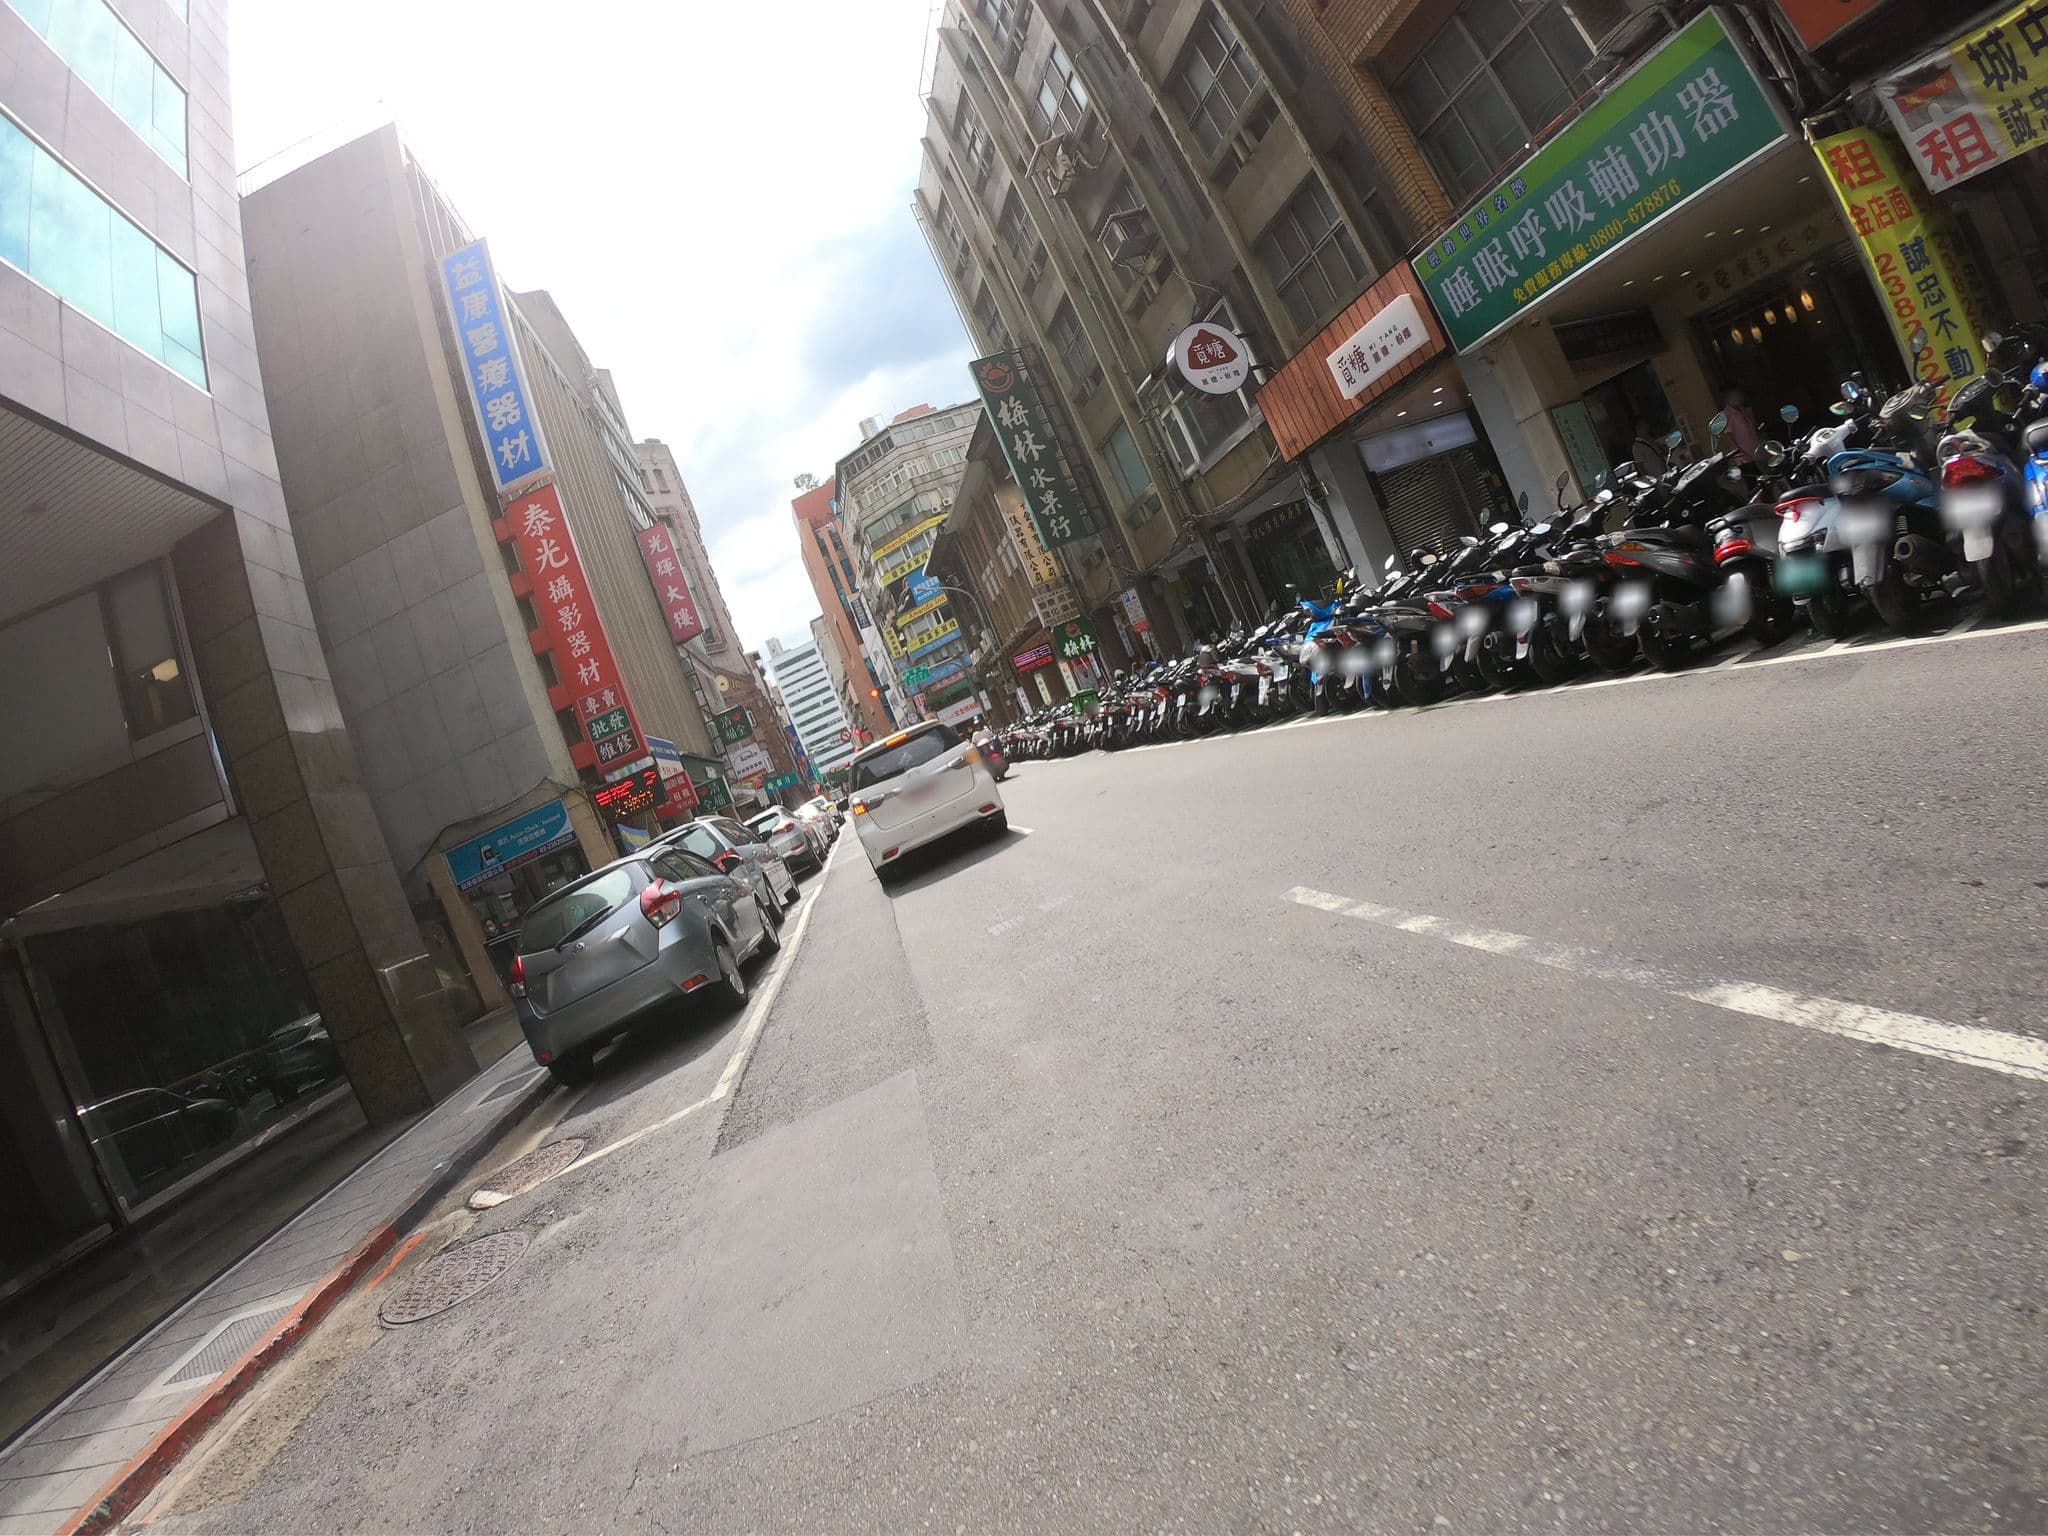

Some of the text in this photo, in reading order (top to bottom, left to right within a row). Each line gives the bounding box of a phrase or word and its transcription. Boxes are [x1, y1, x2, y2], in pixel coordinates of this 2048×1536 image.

[1825, 139, 1886, 191] 租
[1916, 112, 1998, 182] 租
[1440, 67, 1740, 319] 睡眠呼吸輔助器
[452, 256, 531, 470] 益康醫療器材
[997, 395, 1072, 538] 梅林水果行
[523, 503, 601, 687] 泰光攝影器材
[648, 534, 695, 630] 光輝大樓
[1064, 634, 1096, 658] 梅林
[590, 711, 624, 739] 批發
[599, 733, 635, 762] 維修
